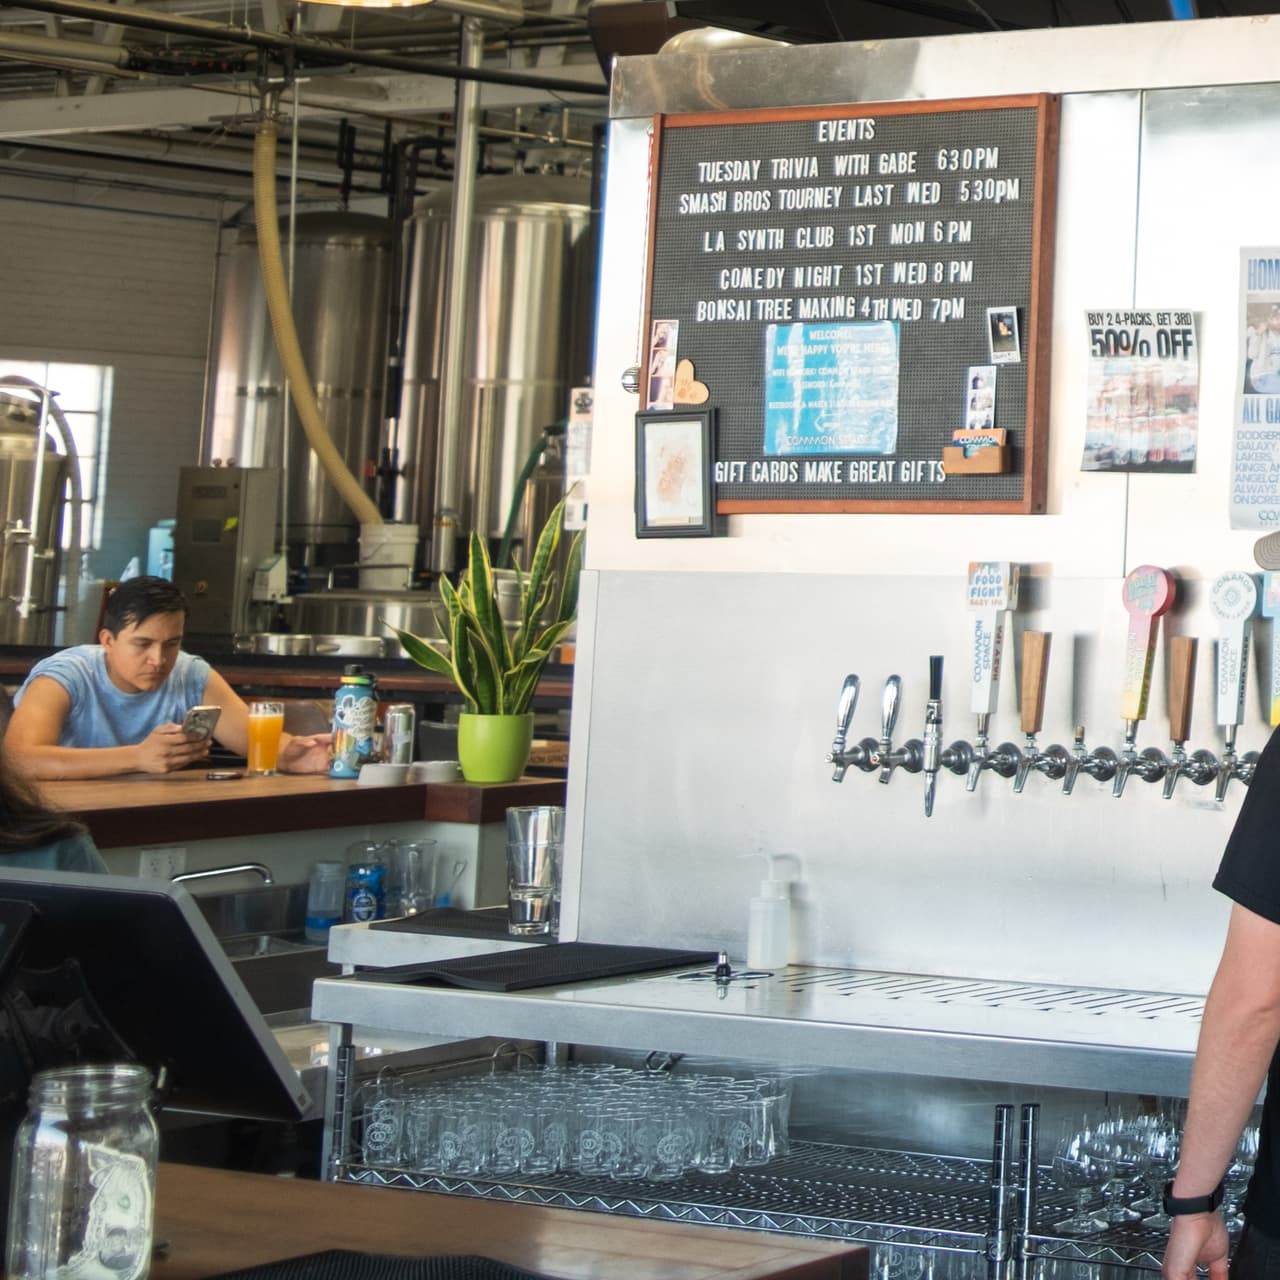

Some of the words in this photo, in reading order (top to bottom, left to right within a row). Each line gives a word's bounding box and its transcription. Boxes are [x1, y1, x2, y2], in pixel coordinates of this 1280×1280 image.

[819, 119, 875, 141] EVENTS
[699, 160, 760, 183] TUESDAY
[772, 156, 818, 179] TRIVIA
[835, 154, 869, 175] WITH
[879, 151, 917, 173] GABE
[679, 191, 726, 214] SMASH
[734, 190, 771, 212] BROS
[779, 186, 842, 209] TOURNEY
[855, 184, 894, 207] LAST
[907, 181, 941, 204] WED
[704, 231, 725, 252] LA
[738, 227, 784, 250] SYNTH
[797, 226, 834, 248] CLUB
[849, 224, 876, 246] 1ST
[891, 222, 925, 244] MON
[948, 221, 972, 242] PM
[720, 267, 785, 290] COMEDY
[794, 265, 843, 288] NIGHT
[856, 263, 884, 286] 1ST
[893, 262, 927, 285] WED
[934, 262, 944, 283] 8
[949, 261, 973, 283] PM
[697, 300, 751, 322] BONSAI
[757, 298, 792, 319] TREE
[799, 296, 855, 319] MAKING
[861, 298, 888, 319] 4TH
[892, 298, 922, 320] WED
[1088, 313, 1104, 326] BUY
[1106, 313, 1114, 326] 2
[1157, 313, 1172, 326] GET
[1174, 313, 1192, 326] 3RD
[1091, 328, 1150, 358] 50%
[1157, 328, 1193, 361] OFF
[1242, 398, 1261, 425] ALL
[715, 462, 745, 484] GIFT
[751, 462, 798, 483] CARDS
[804, 461, 842, 483] MAKE
[849, 461, 896, 483] GREAT
[901, 461, 946, 483] GIFTS
[1234, 485, 1276, 493] ALWAYS
[971, 587, 1002, 597] FIGHT
[976, 576, 1001, 585] FOOD
